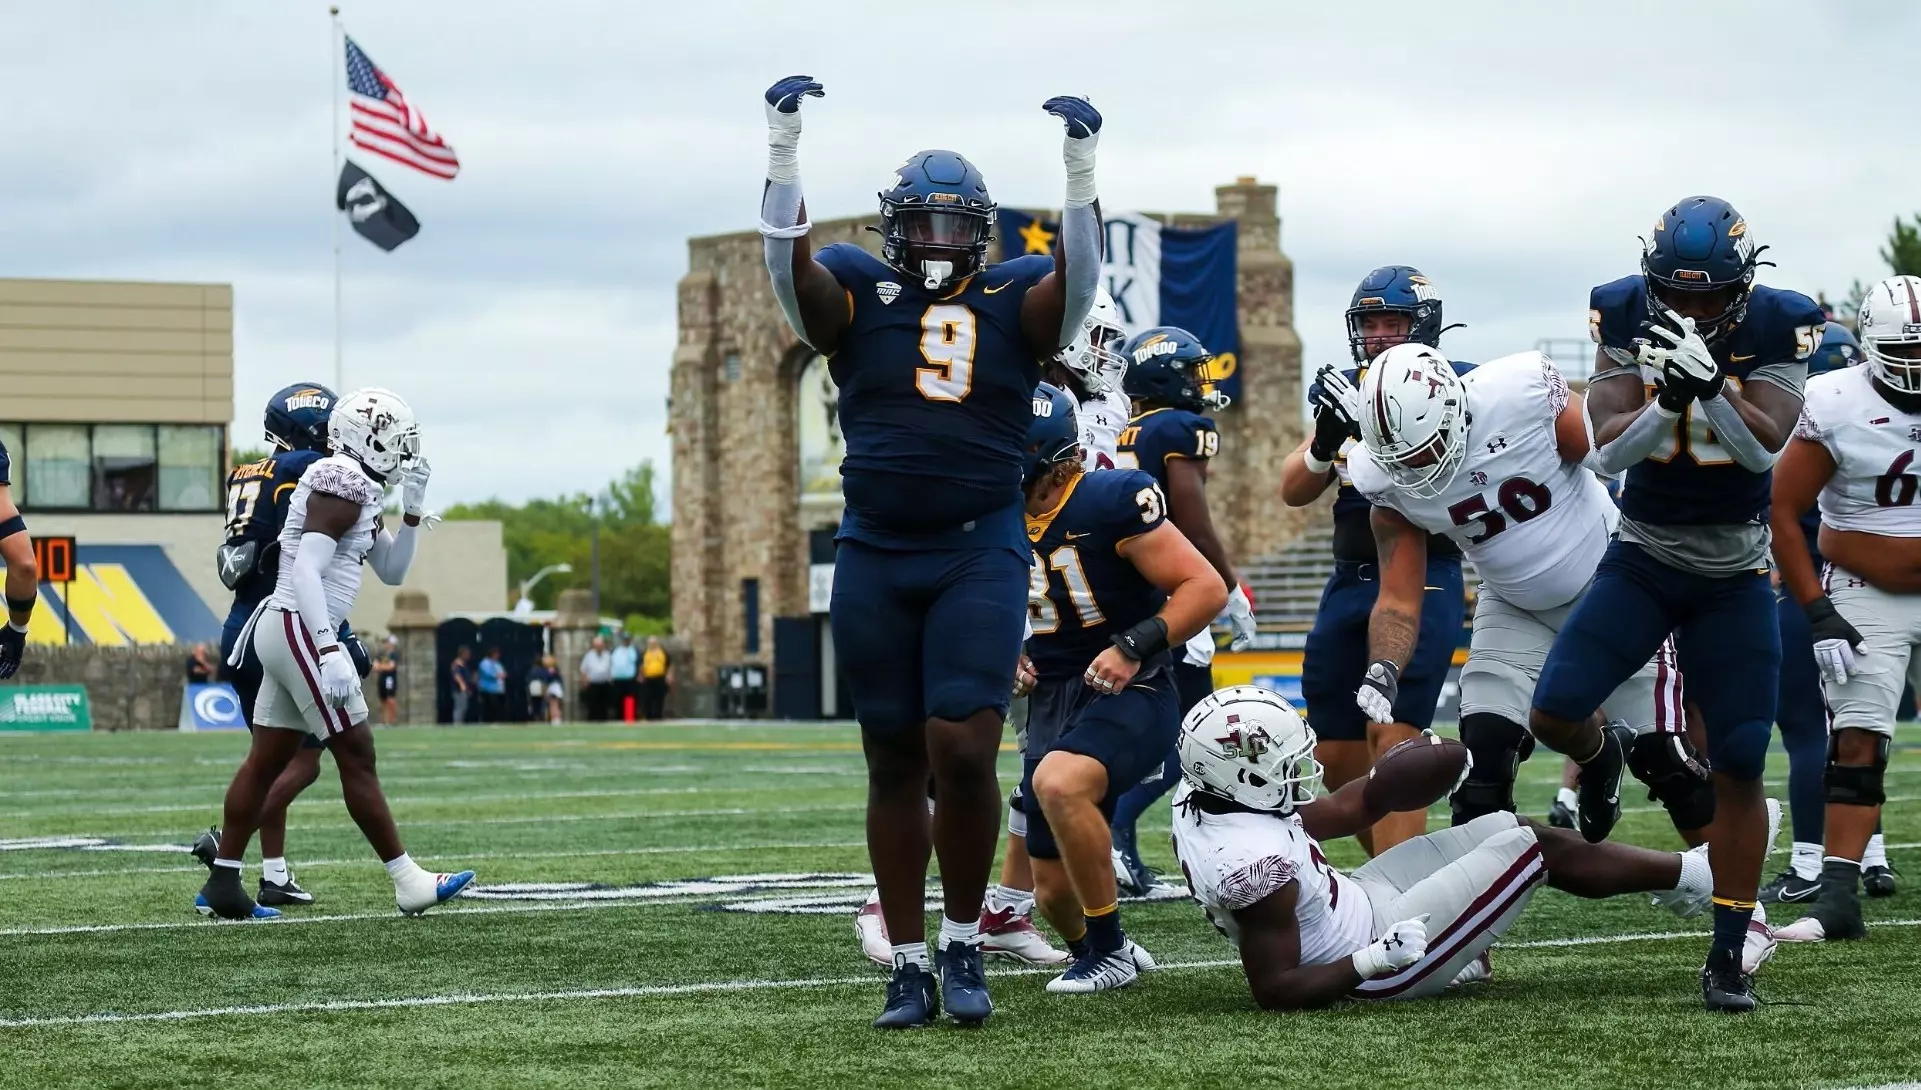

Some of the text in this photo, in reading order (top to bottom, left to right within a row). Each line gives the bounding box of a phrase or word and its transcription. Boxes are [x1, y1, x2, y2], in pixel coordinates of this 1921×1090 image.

[915, 303, 977, 403] 9
[1132, 341, 1178, 366] TOLEDO
[1196, 429, 1219, 457] 19
[1135, 482, 1168, 524] 31
[1447, 476, 1552, 545] 50
